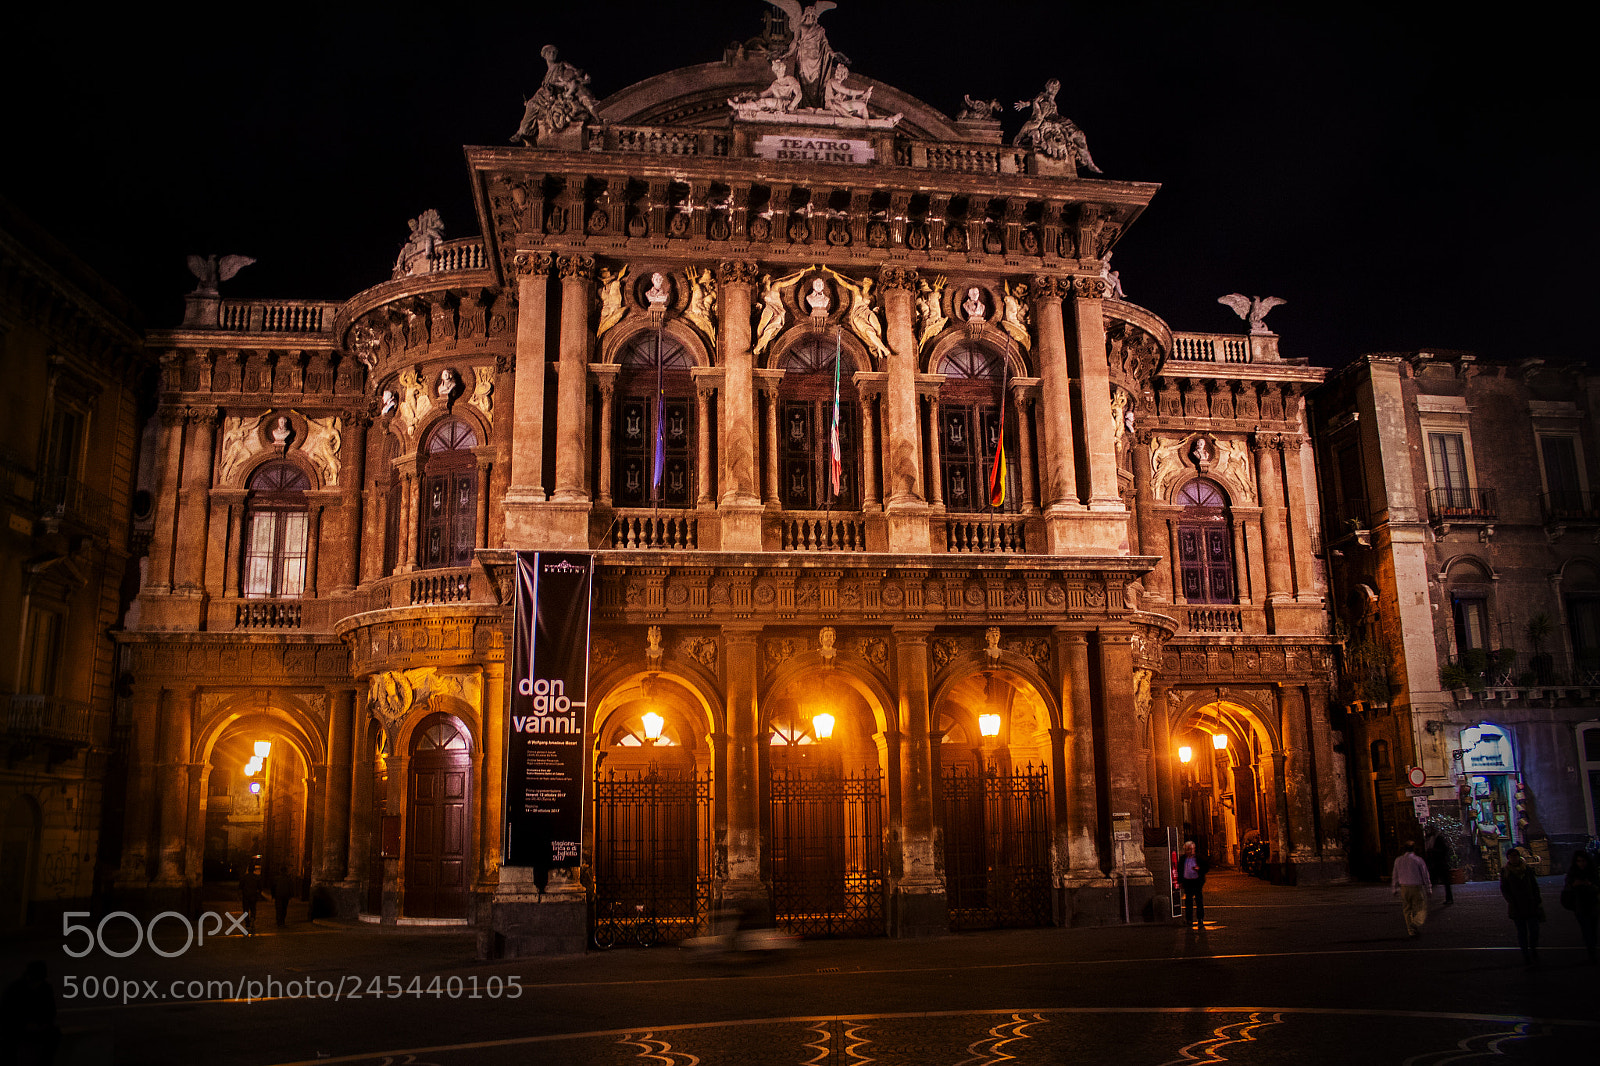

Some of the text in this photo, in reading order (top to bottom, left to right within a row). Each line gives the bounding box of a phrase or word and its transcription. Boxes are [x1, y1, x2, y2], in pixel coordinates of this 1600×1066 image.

[780, 139, 851, 151] TEATRO
[776, 150, 855, 162] BELLINI
[518, 673, 564, 696] don
[512, 711, 581, 734] vanni.
